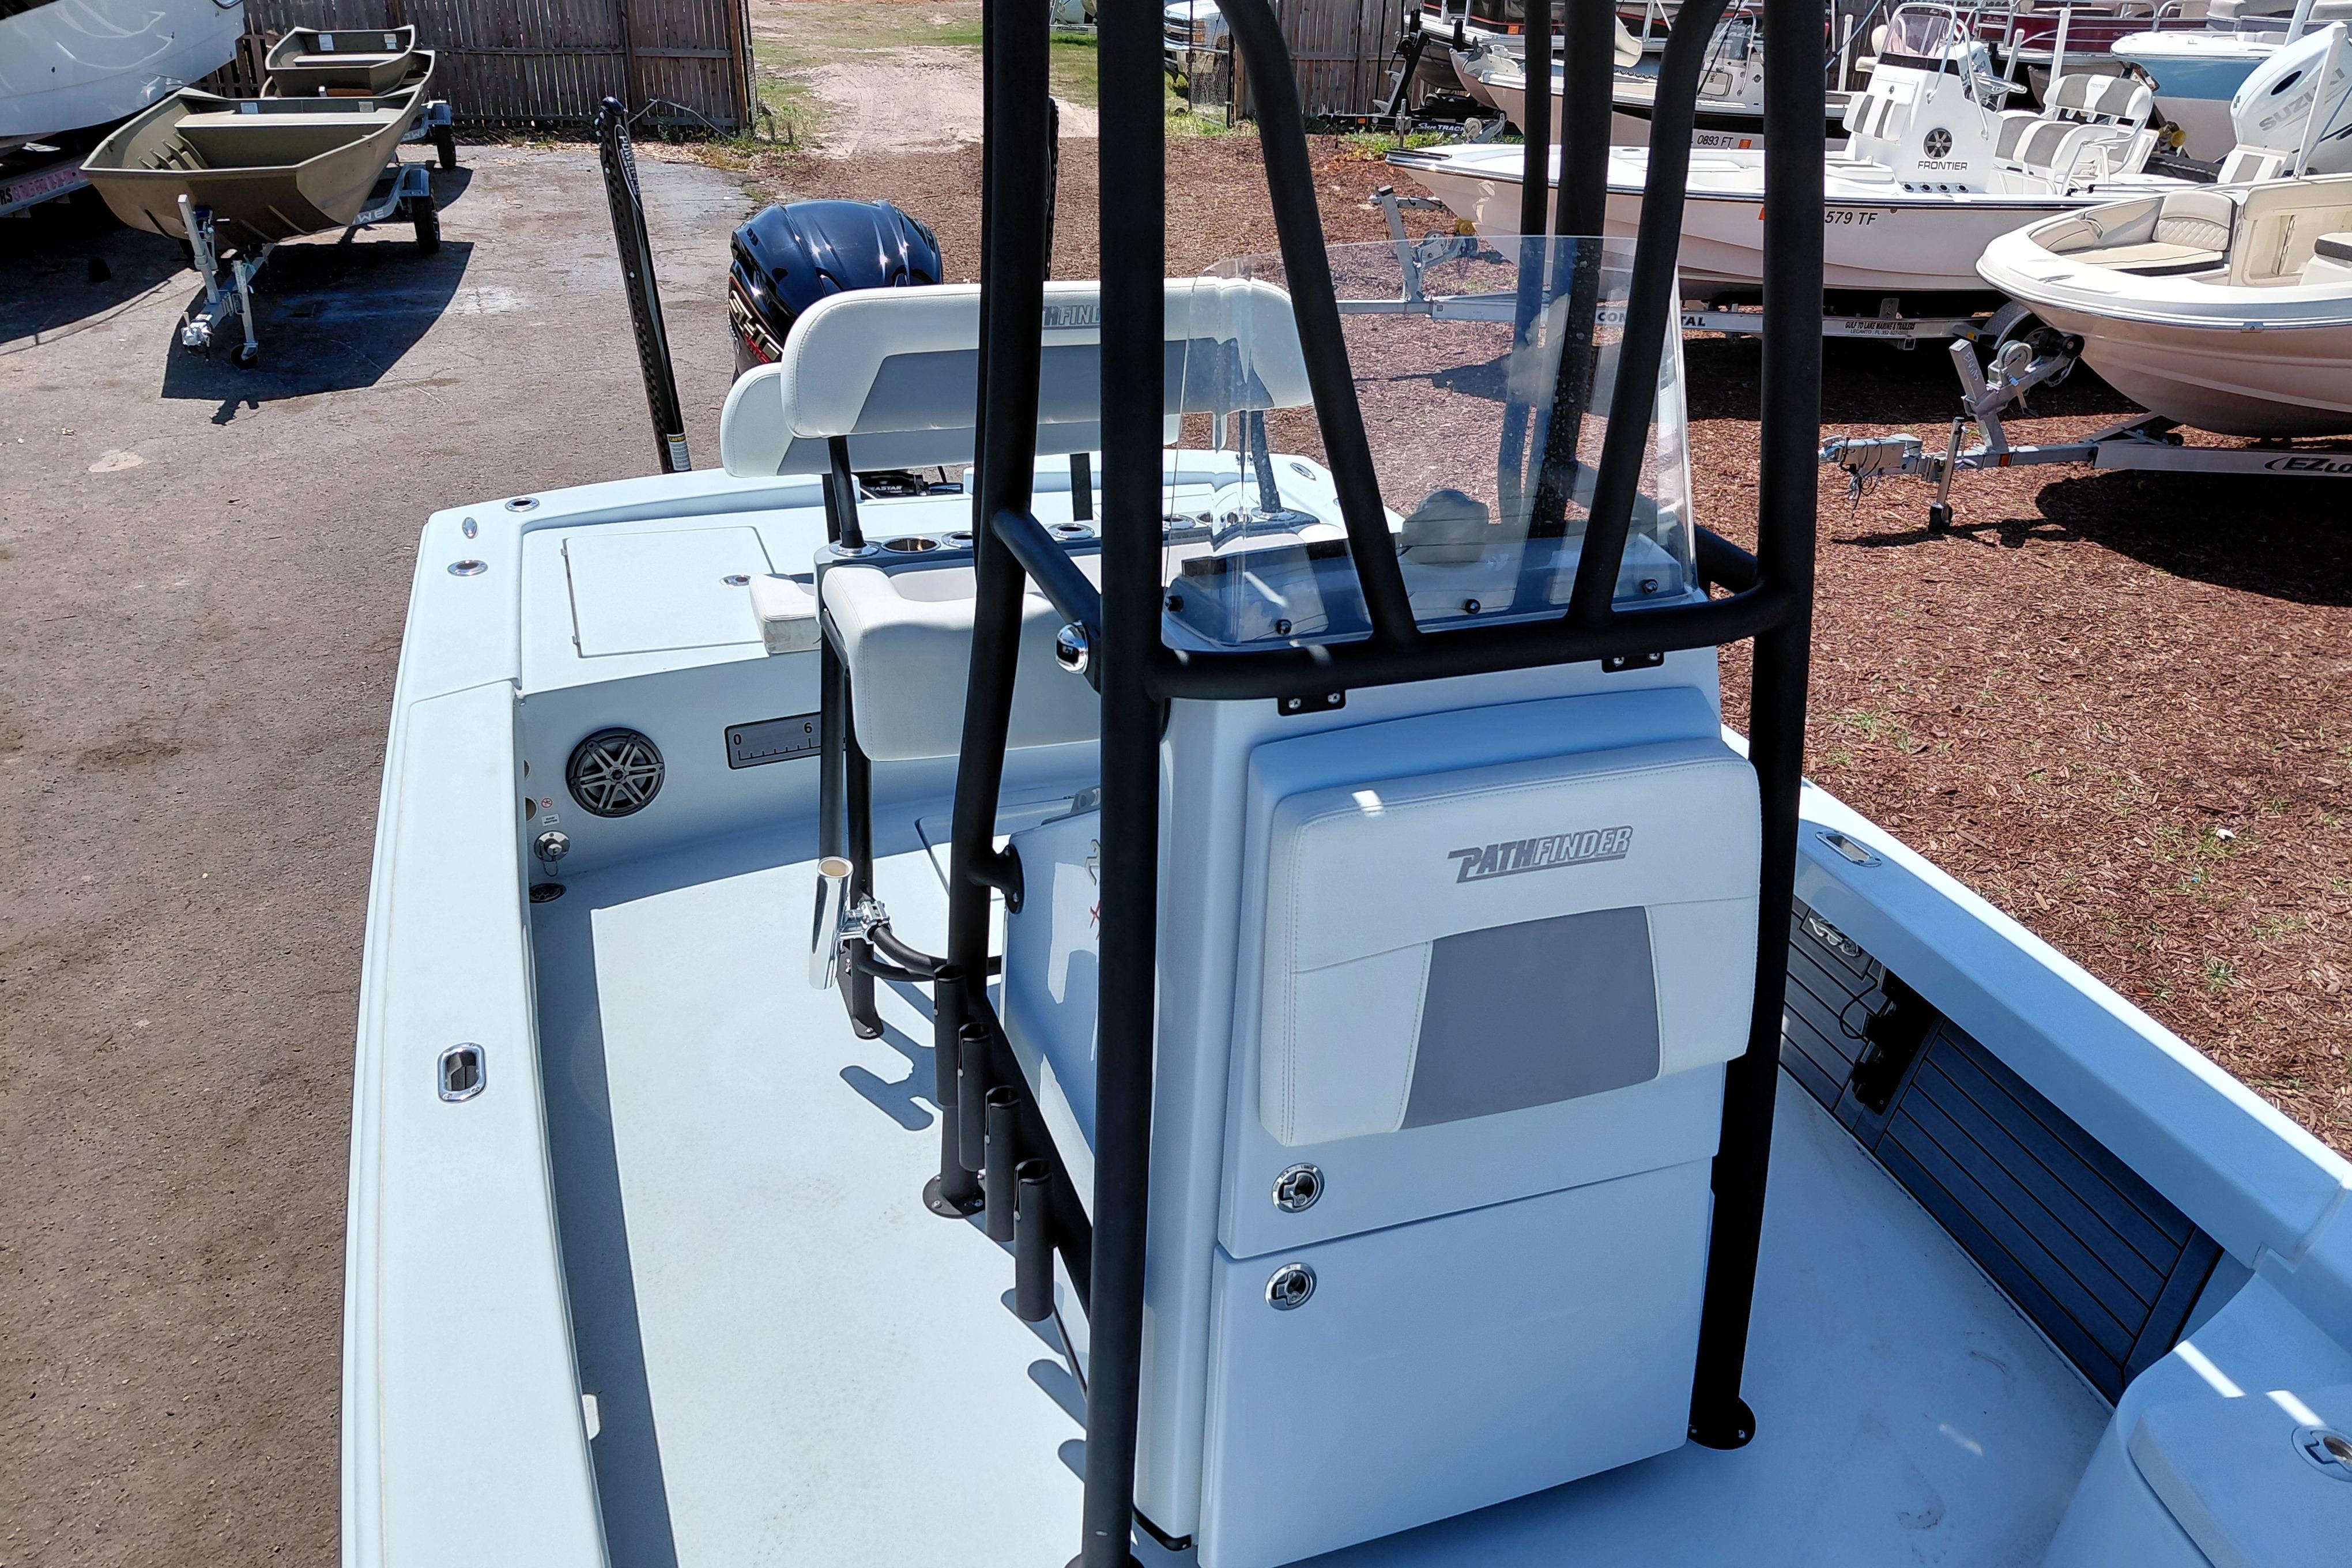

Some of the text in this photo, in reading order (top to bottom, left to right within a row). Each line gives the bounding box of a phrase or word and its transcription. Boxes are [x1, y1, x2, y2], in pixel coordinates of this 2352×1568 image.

[1697, 135, 1733, 148] 0893 FT
[1917, 161, 1967, 171] FRONTIER
[1859, 212, 1878, 225] TF
[733, 722, 812, 745] 0 6
[1448, 825, 1633, 884] PATHFINDER
